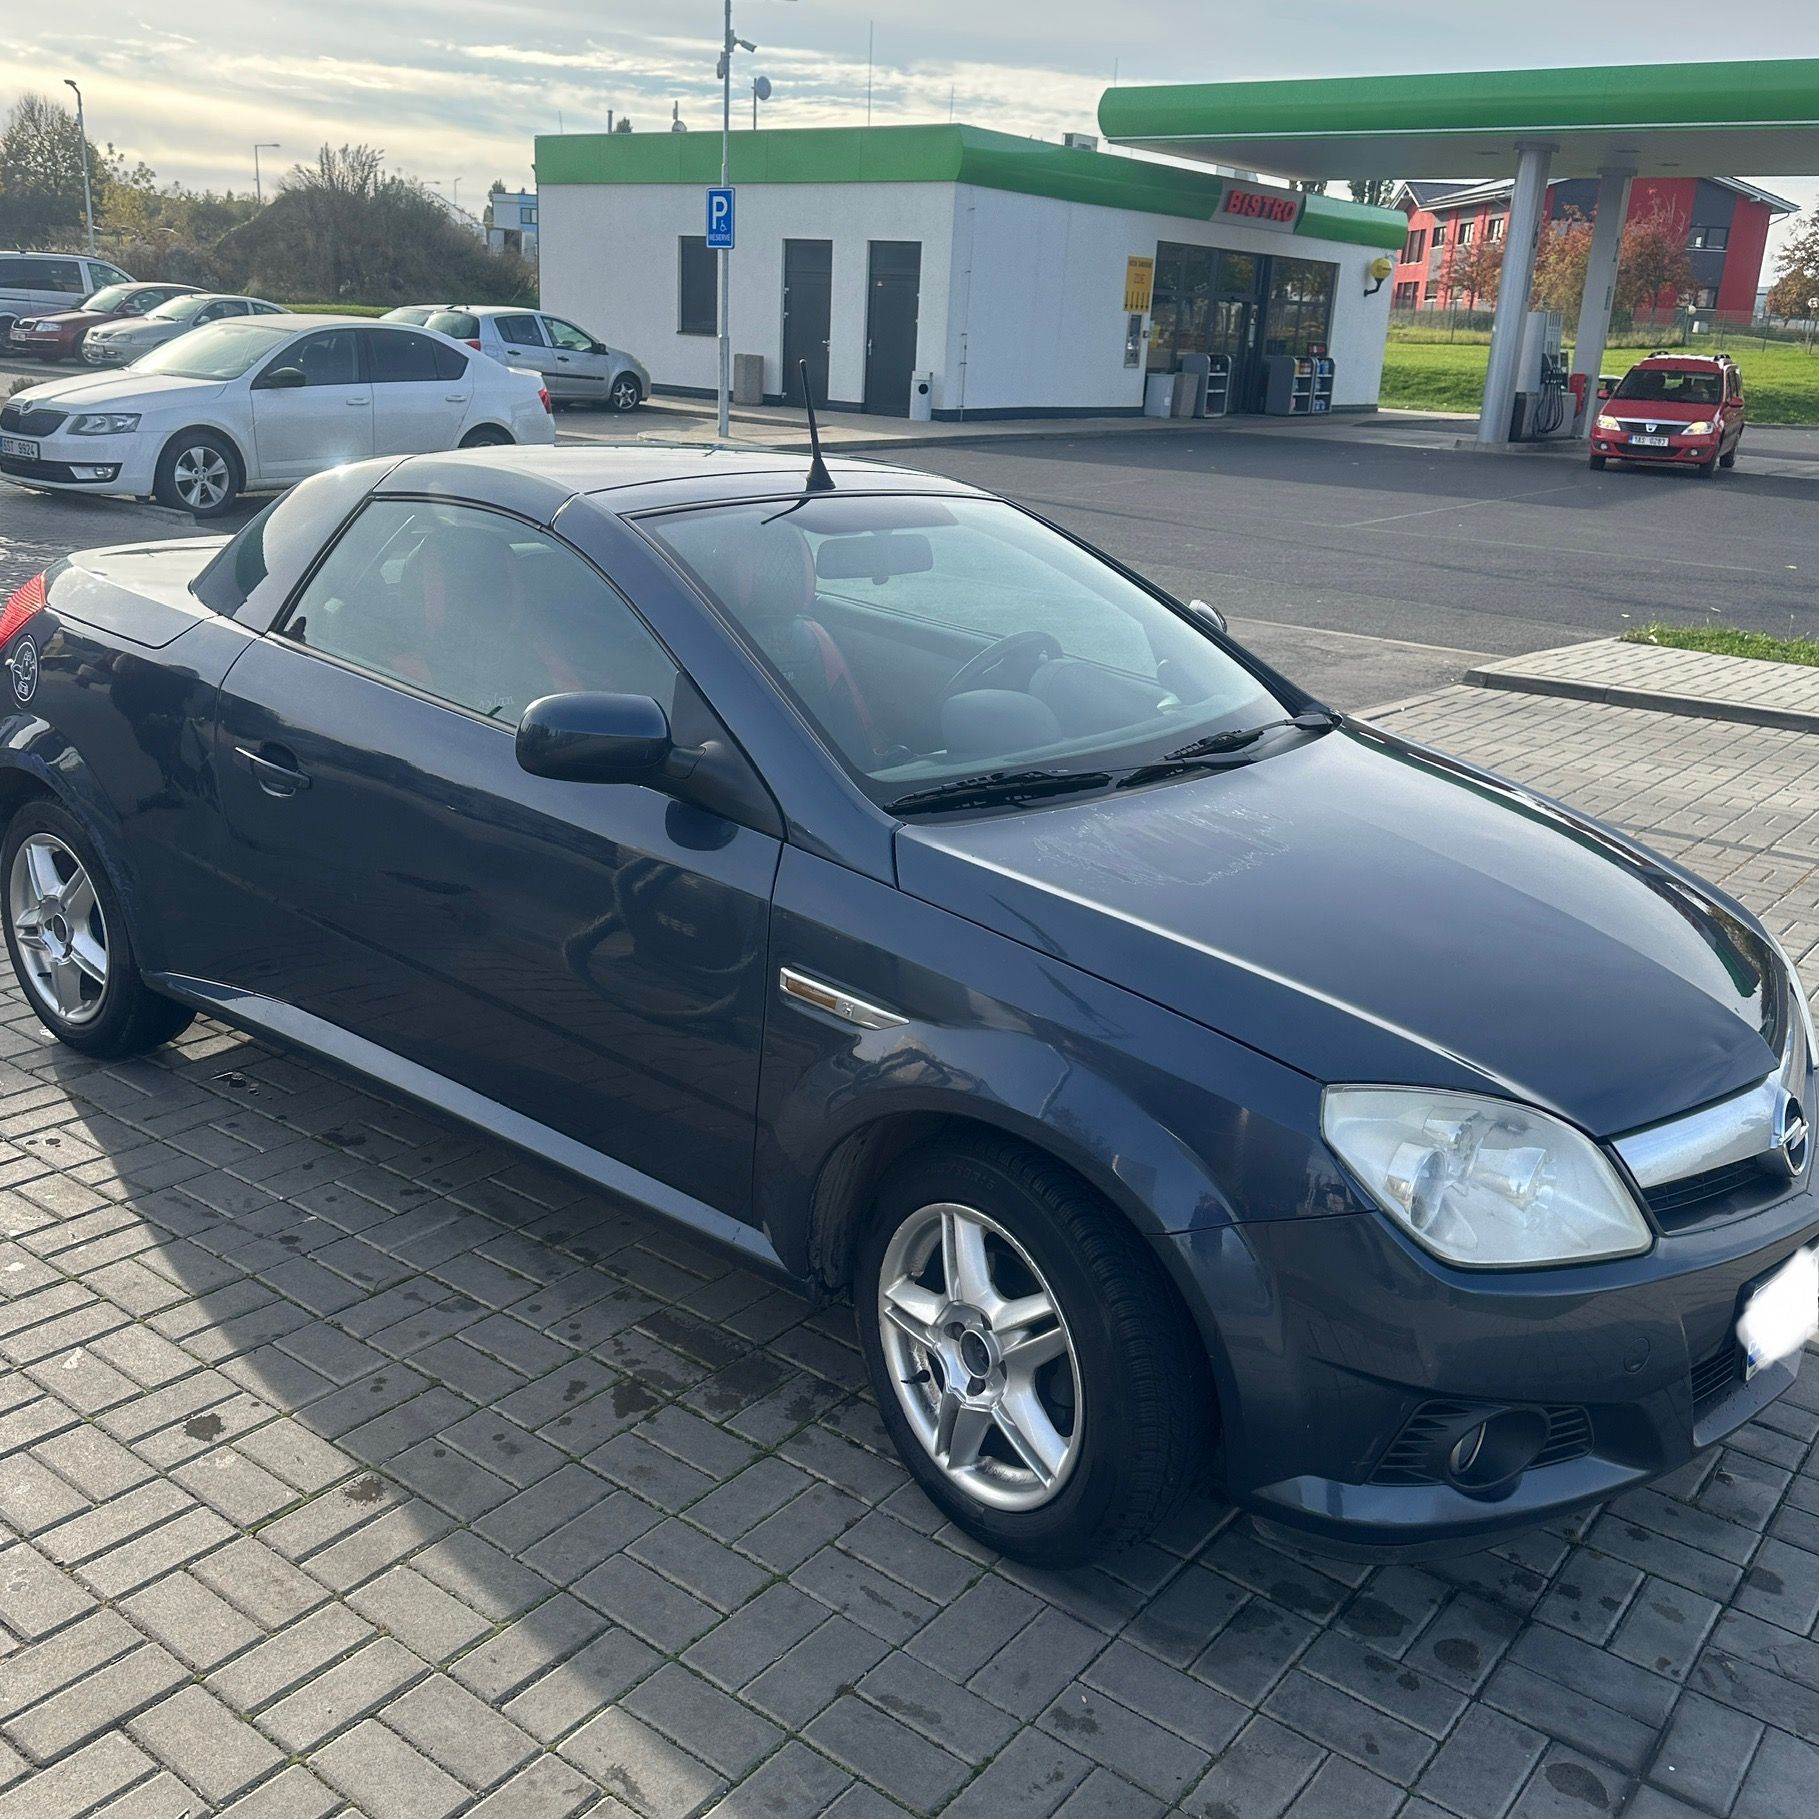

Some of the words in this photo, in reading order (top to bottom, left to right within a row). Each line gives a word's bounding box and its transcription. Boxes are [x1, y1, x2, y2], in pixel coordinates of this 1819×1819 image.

[712, 196, 728, 229] P
[1225, 189, 1297, 223] BISTRO
[18, 442, 35, 457] 9924
